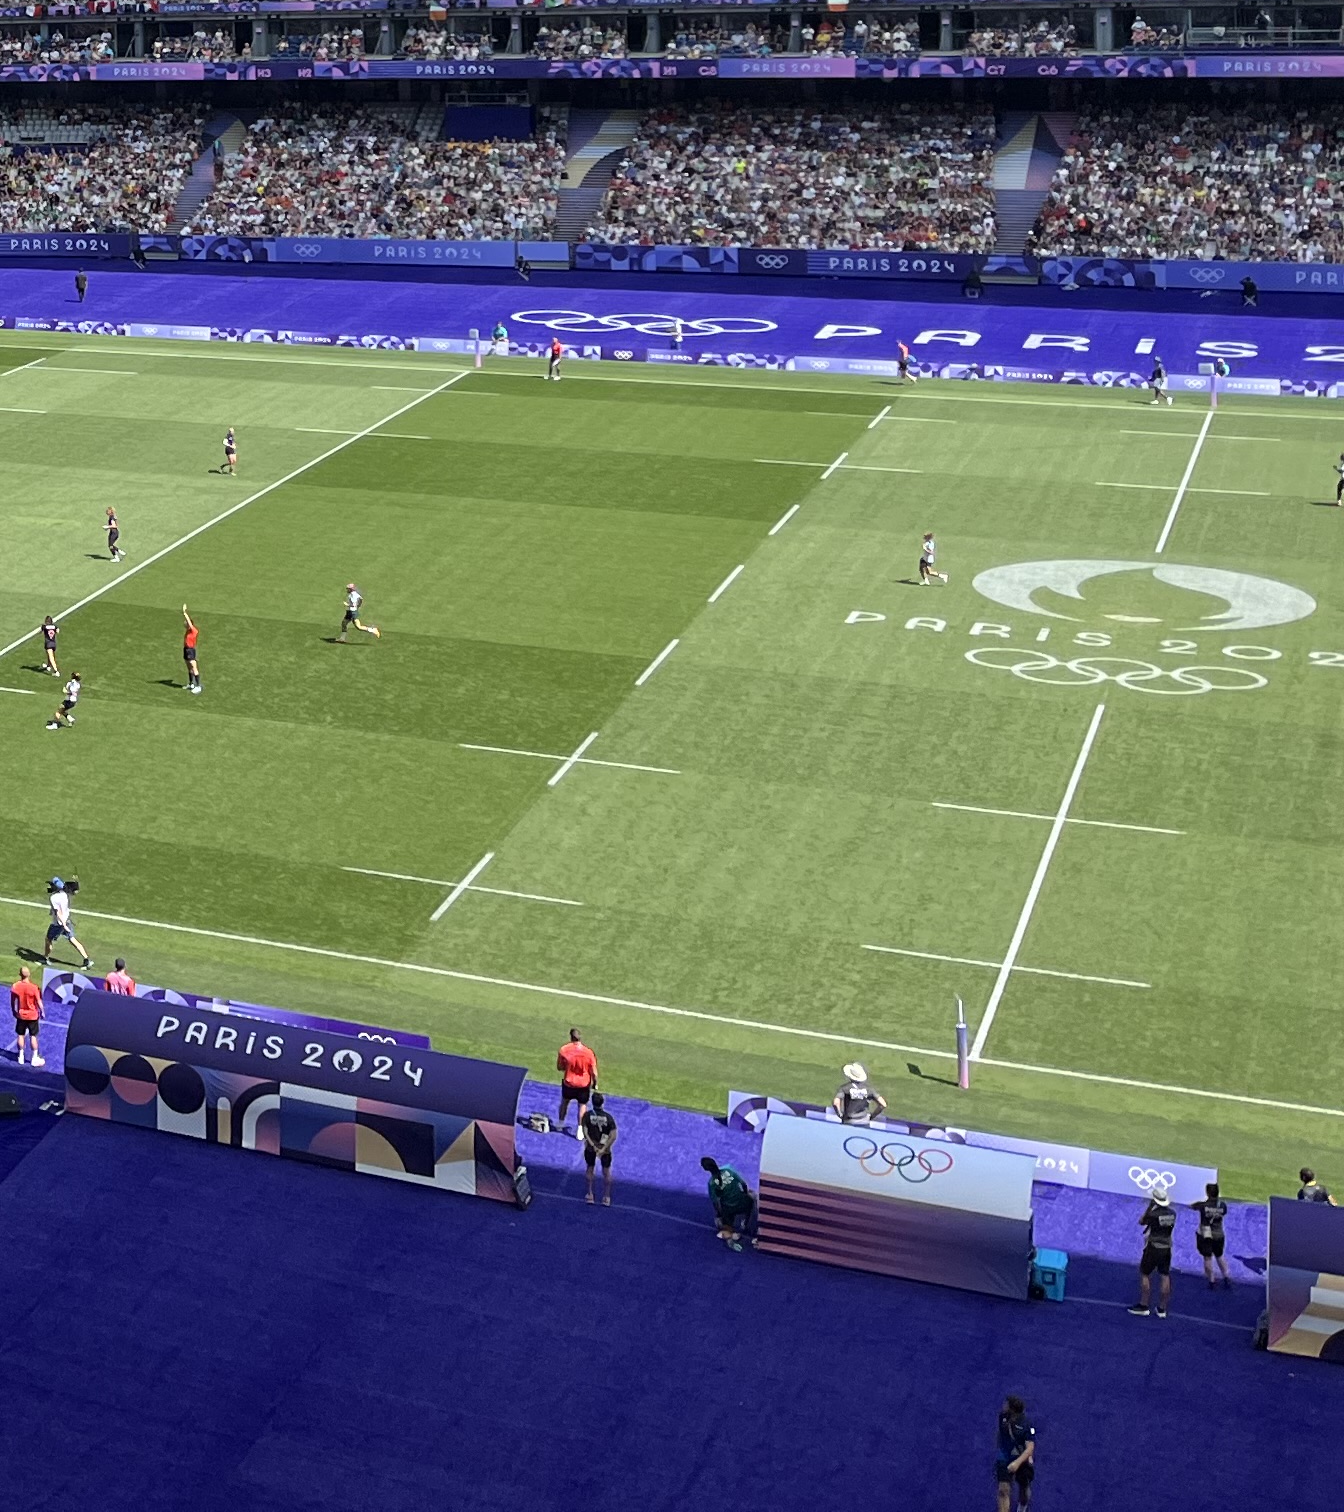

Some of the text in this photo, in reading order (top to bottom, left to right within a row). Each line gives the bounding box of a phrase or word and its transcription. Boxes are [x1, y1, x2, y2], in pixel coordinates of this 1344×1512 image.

[153, 67, 186, 76] 2024
[459, 65, 494, 75] 2024
[792, 63, 831, 73] 2024
[1278, 62, 1321, 72] 2024
[10, 239, 109, 251] PARIS 2024
[375, 246, 480, 259] PARIS 2024
[828, 258, 954, 273] PARIS 2024
[1296, 271, 1344, 285] PAR
[813, 324, 1259, 359] PARIS
[844, 610, 1112, 648] PARIS
[156, 1015, 423, 1087] PARIS 2024
